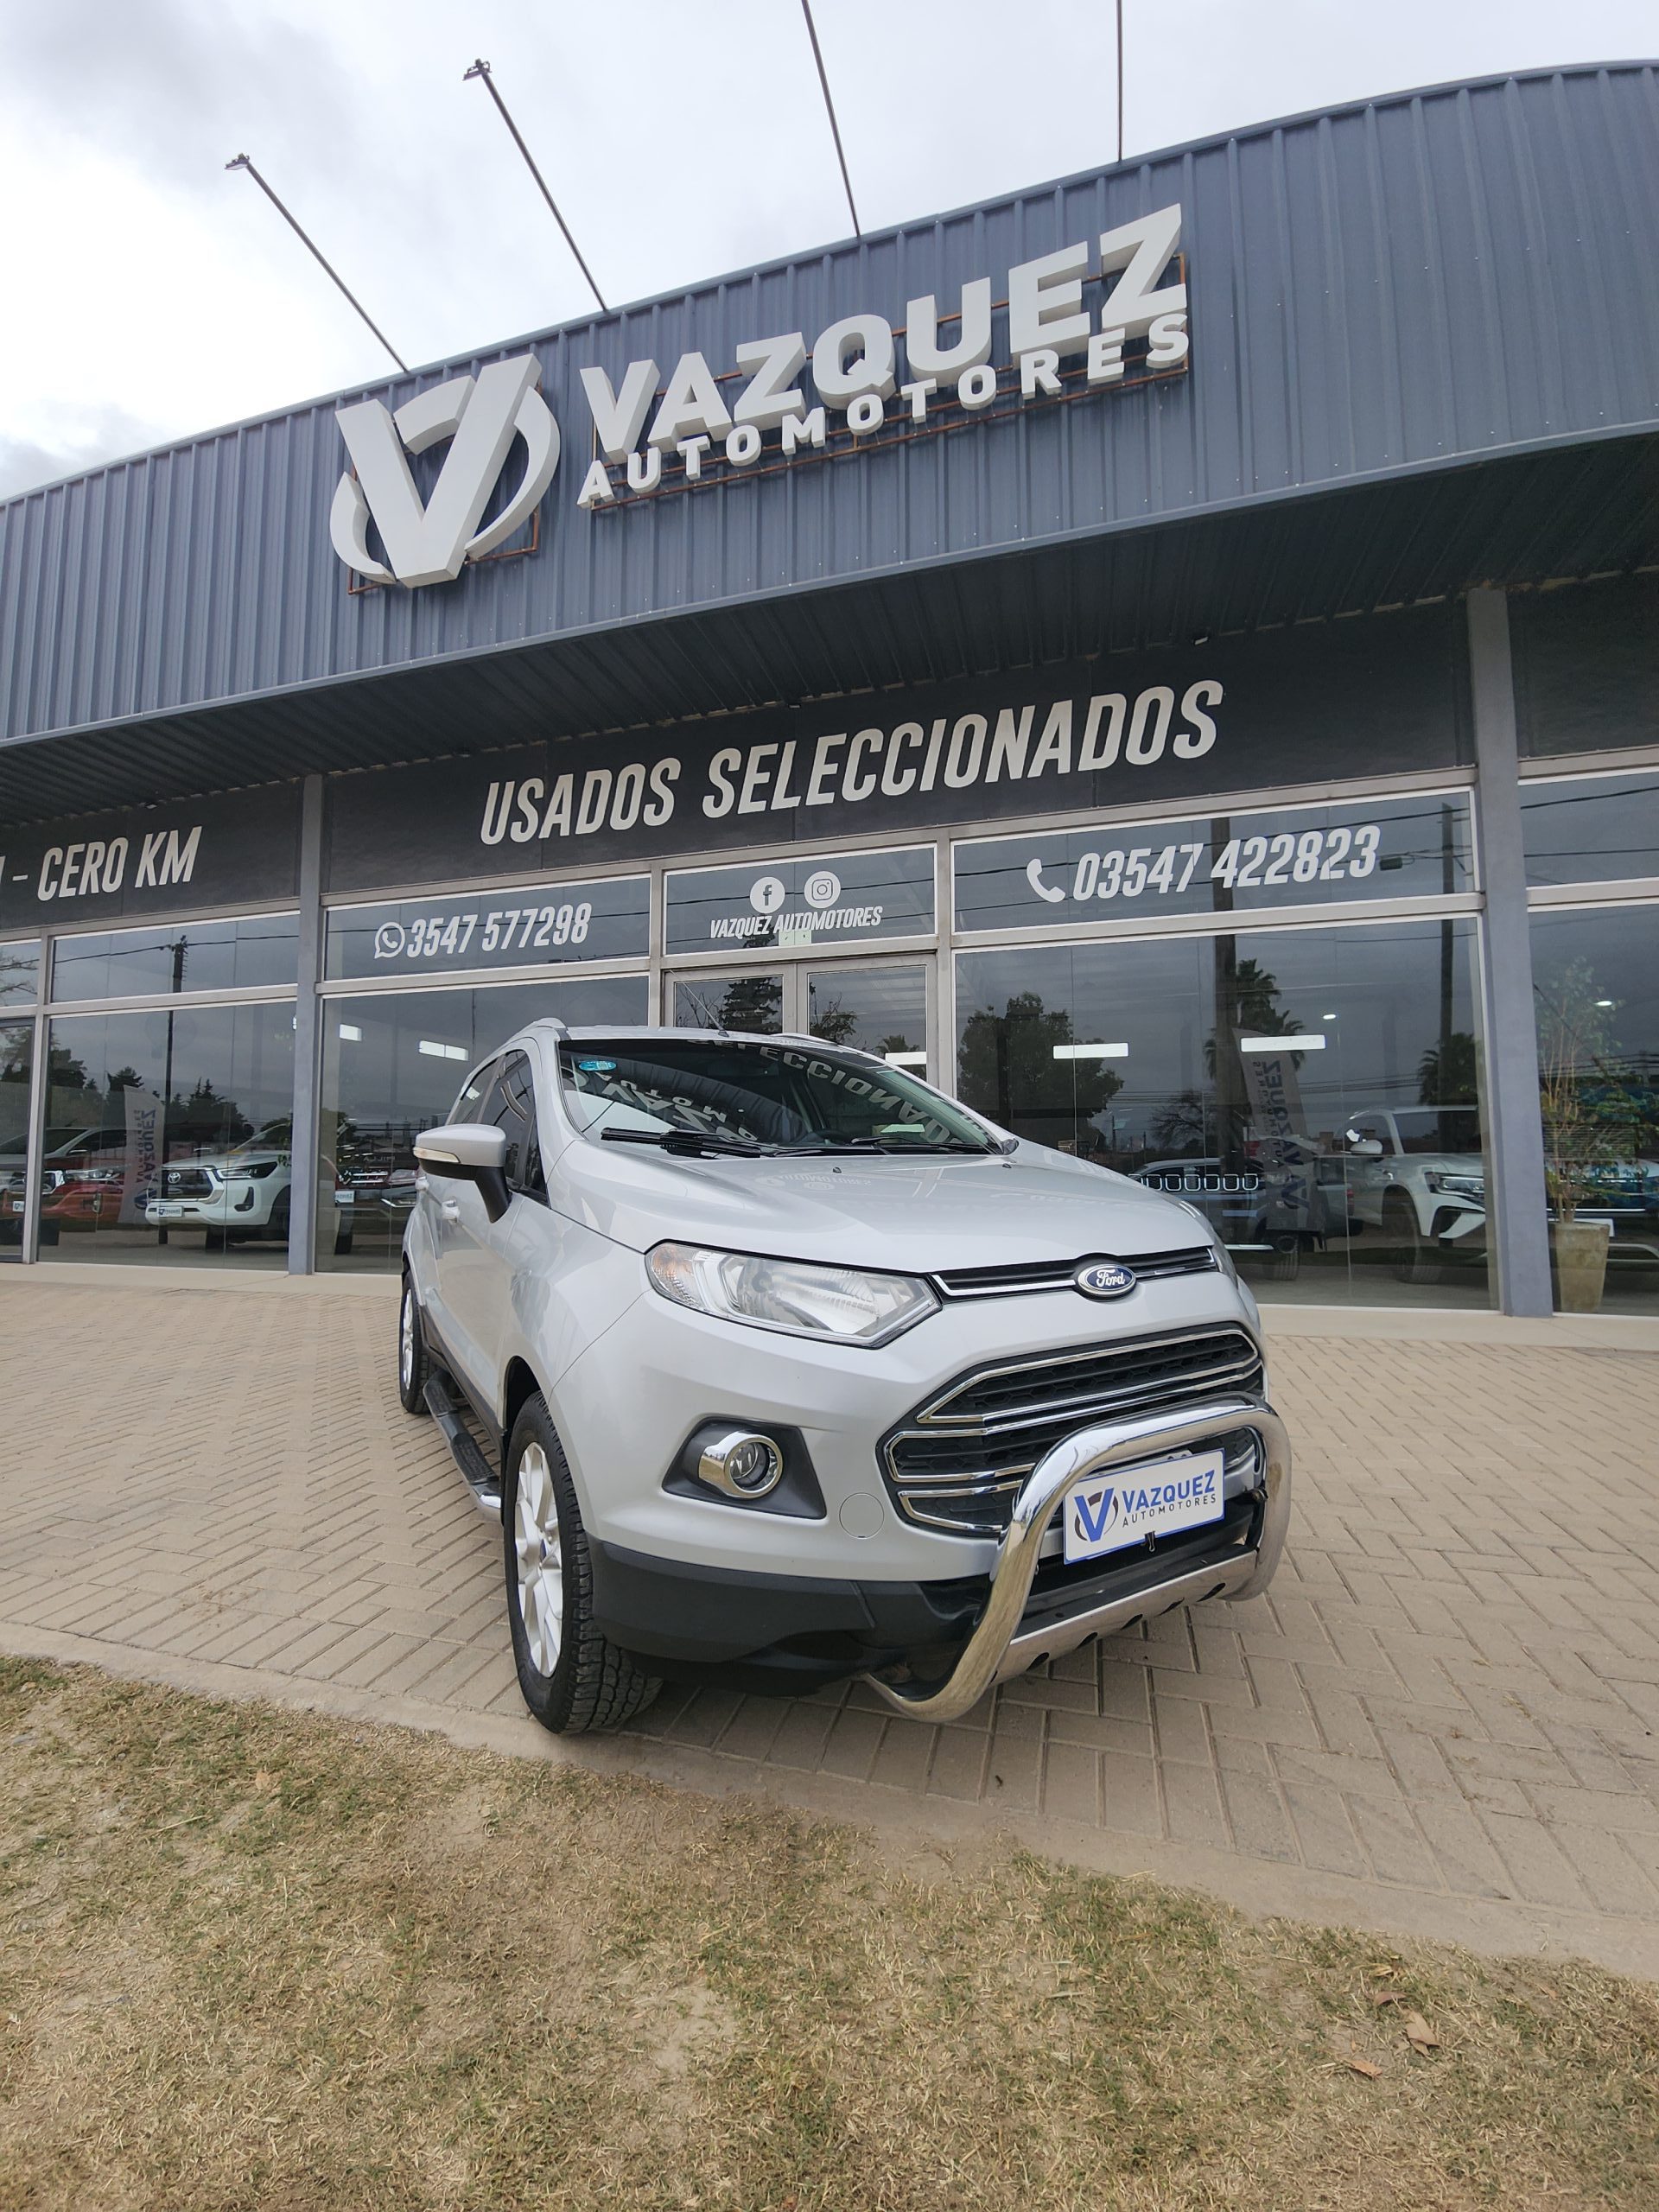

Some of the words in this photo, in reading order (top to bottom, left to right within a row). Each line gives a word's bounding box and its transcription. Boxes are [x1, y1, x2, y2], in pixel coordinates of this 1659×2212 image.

[579, 203, 1187, 464] VAZQUEZ
[576, 313, 1190, 510] AUTOMOTORES
[480, 757, 681, 845] USADOS
[702, 679, 1224, 819] SELECCIONADOS
[37, 836, 128, 902] CERO
[133, 826, 202, 888] KM
[1073, 843, 1199, 902] 03547
[1211, 824, 1381, 889] 422823
[405, 916, 479, 959] 3547
[483, 902, 592, 950] 577298
[710, 915, 772, 939] VAZQUEZ
[772, 906, 883, 934] AUTOMOTORES
[1096, 1268, 1127, 1288] Ford
[1122, 1470, 1216, 1514] VAZQUEZ
[1122, 1494, 1217, 1529] AUTOMOTORES
